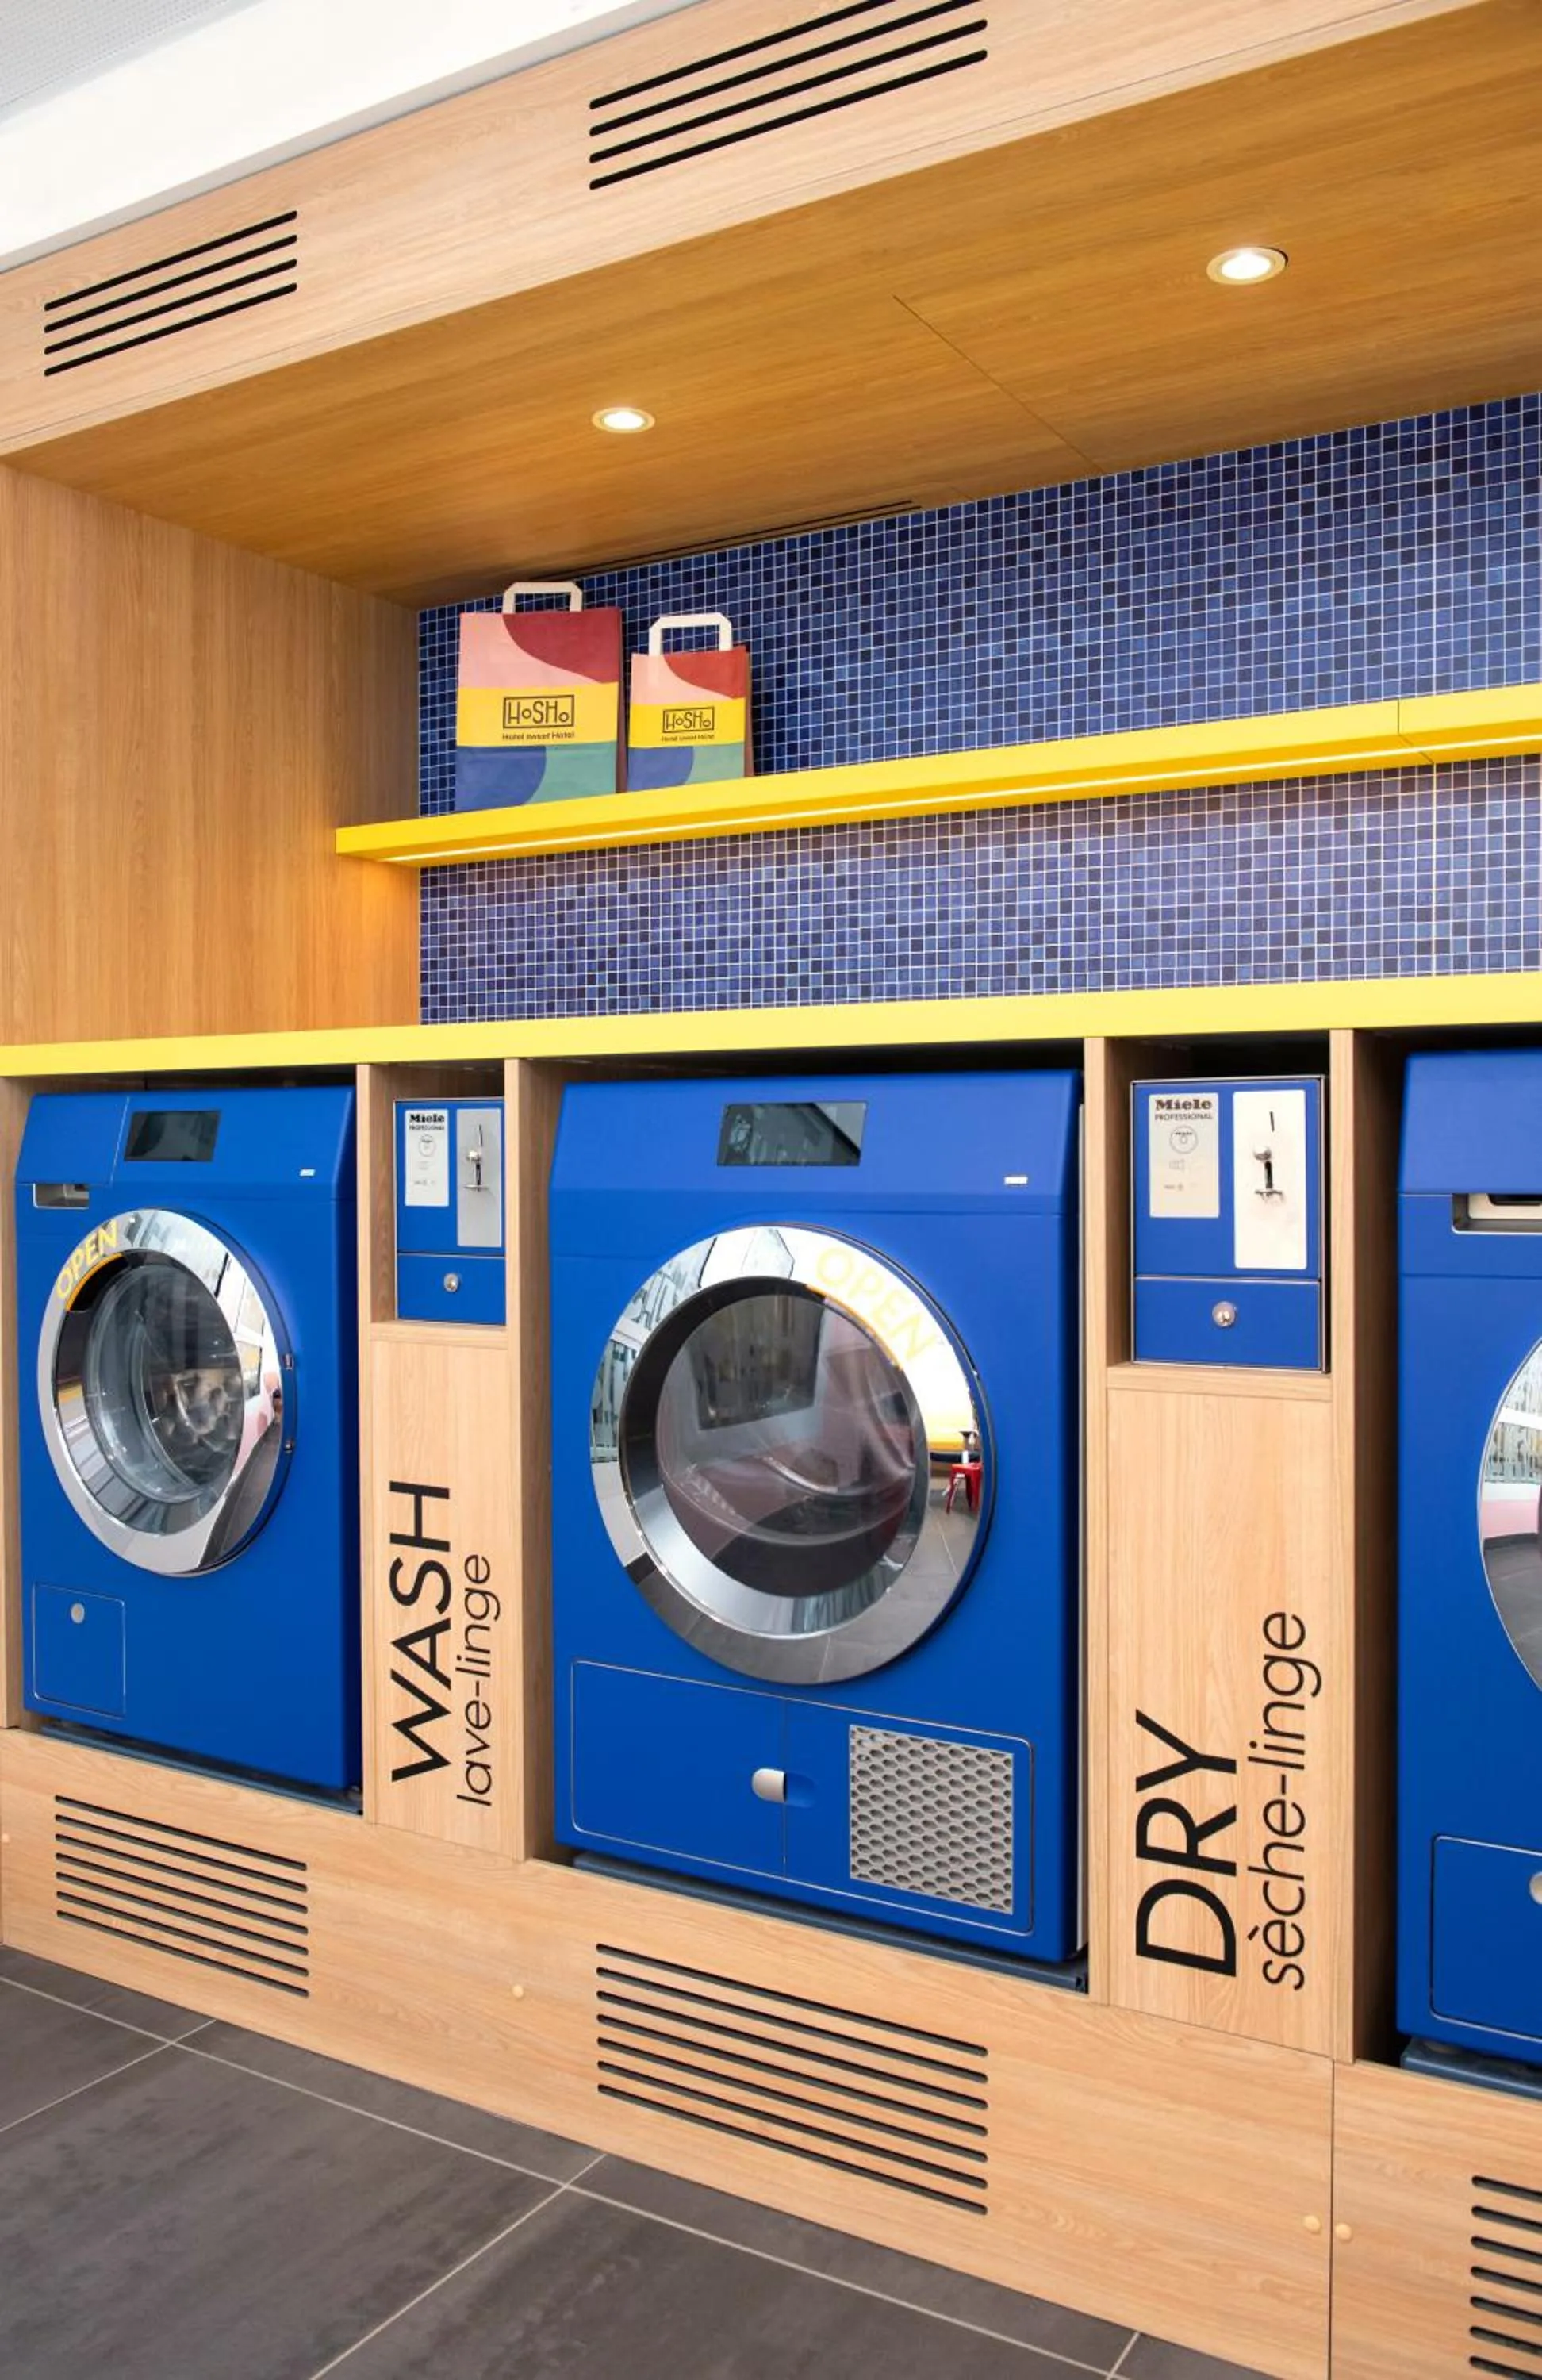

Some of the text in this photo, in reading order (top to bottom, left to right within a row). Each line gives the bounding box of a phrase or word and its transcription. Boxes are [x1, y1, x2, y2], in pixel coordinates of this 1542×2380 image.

[409, 1114, 445, 1123] Miele
[1154, 1112, 1213, 1121] PROFESSIONAL
[1155, 1099, 1213, 1111] Miele
[56, 1219, 117, 1299] OPEN
[815, 1247, 937, 1361] OPEN
[389, 1480, 452, 1783] WASH
[456, 1553, 501, 1807] lave-linge
[1135, 1708, 1237, 1978] DRY
[1247, 1611, 1322, 1991] sèche-linge
